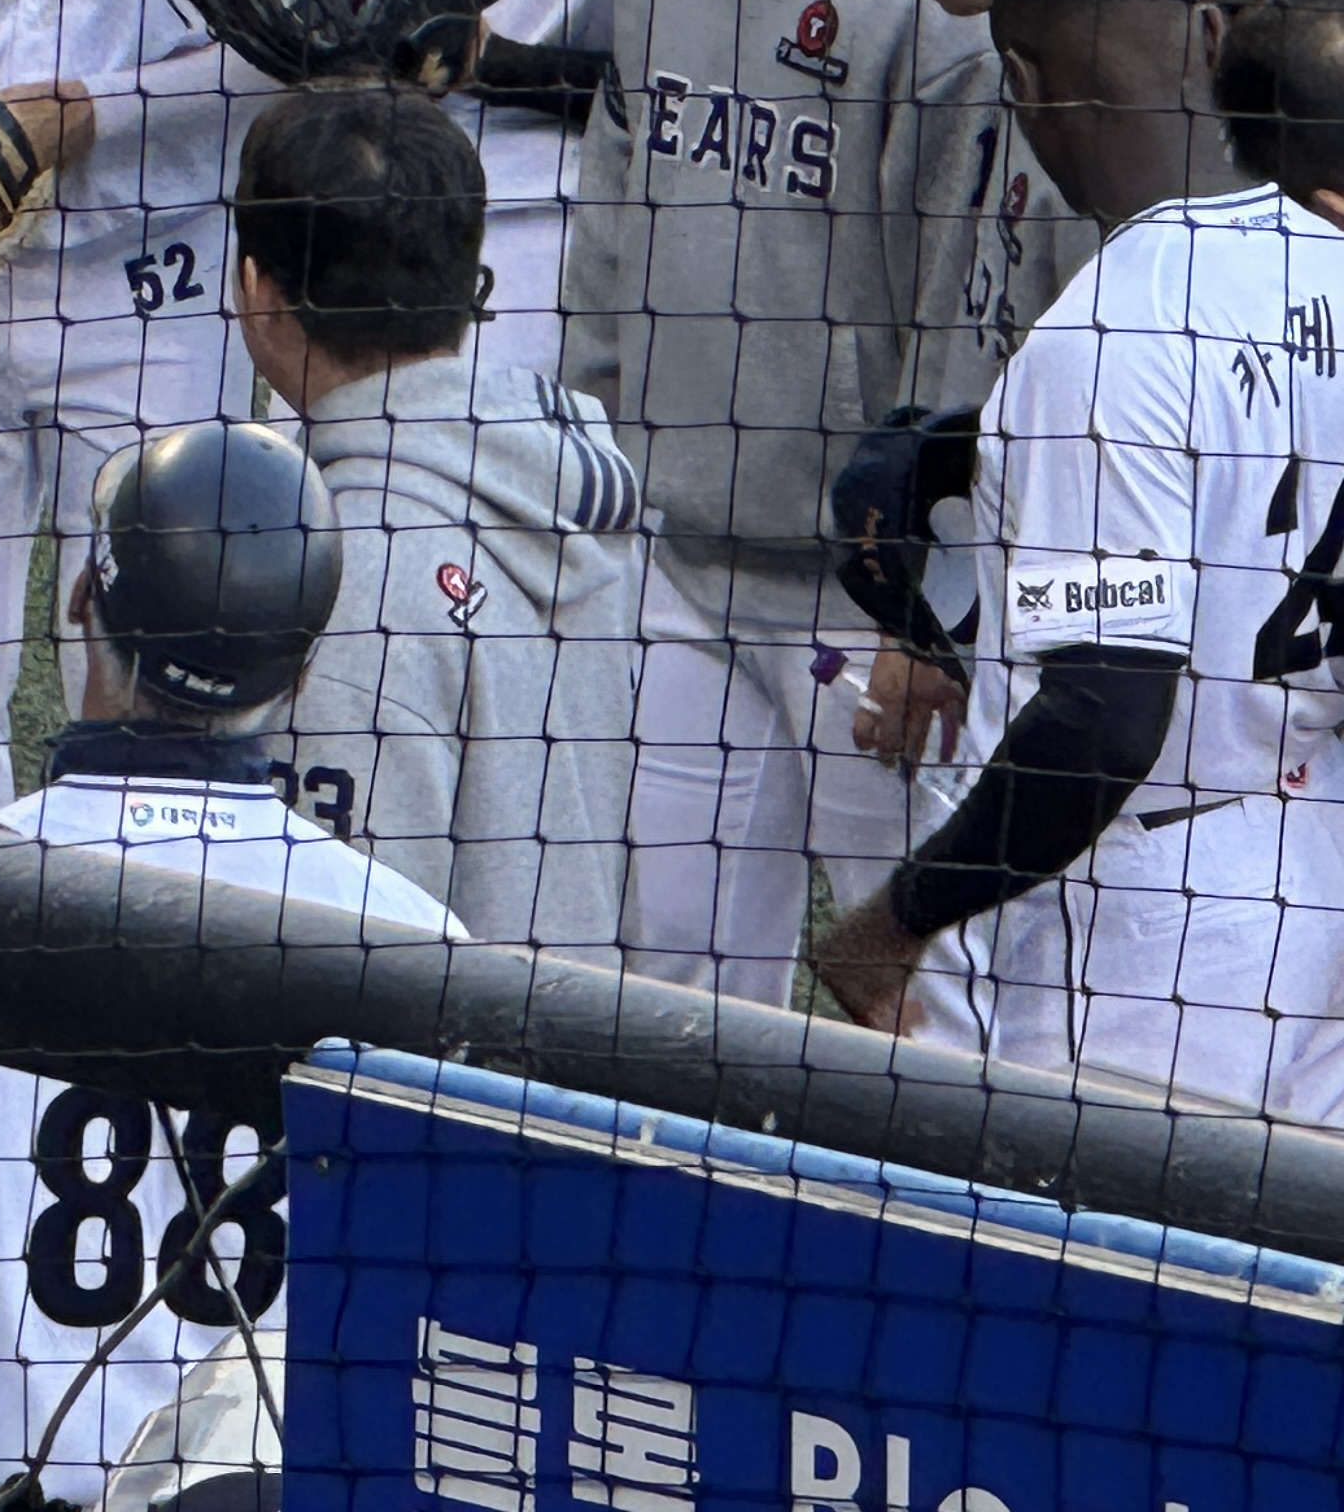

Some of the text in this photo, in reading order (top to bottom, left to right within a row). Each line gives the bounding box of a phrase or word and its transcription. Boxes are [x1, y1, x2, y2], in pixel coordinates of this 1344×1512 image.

[644, 73, 838, 198] EARS
[124, 243, 204, 312] 52
[1065, 573, 1166, 613] Bobcat
[28, 1084, 288, 1328] 88
